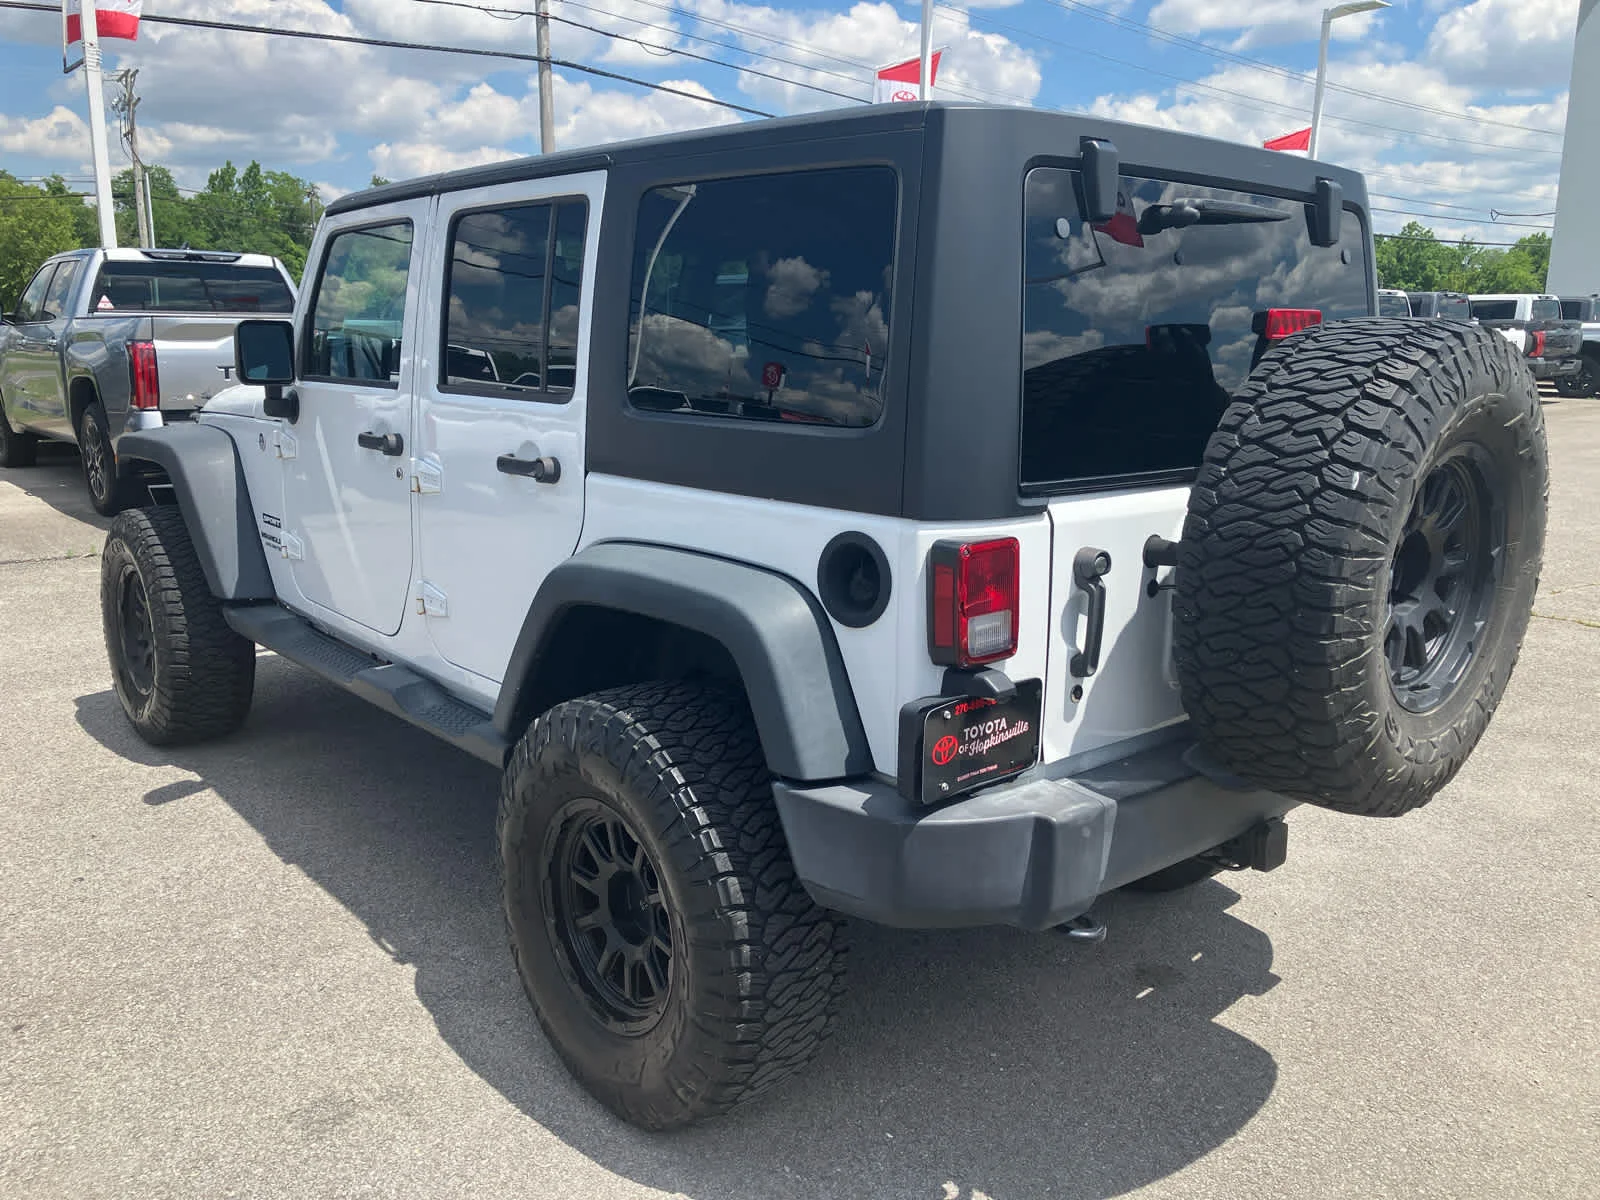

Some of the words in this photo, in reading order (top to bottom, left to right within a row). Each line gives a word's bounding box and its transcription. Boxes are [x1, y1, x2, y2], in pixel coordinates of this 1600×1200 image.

[958, 743, 969, 754] OF
[969, 720, 1029, 756] Hopkinsville
[963, 717, 1007, 741] TOYOTA
